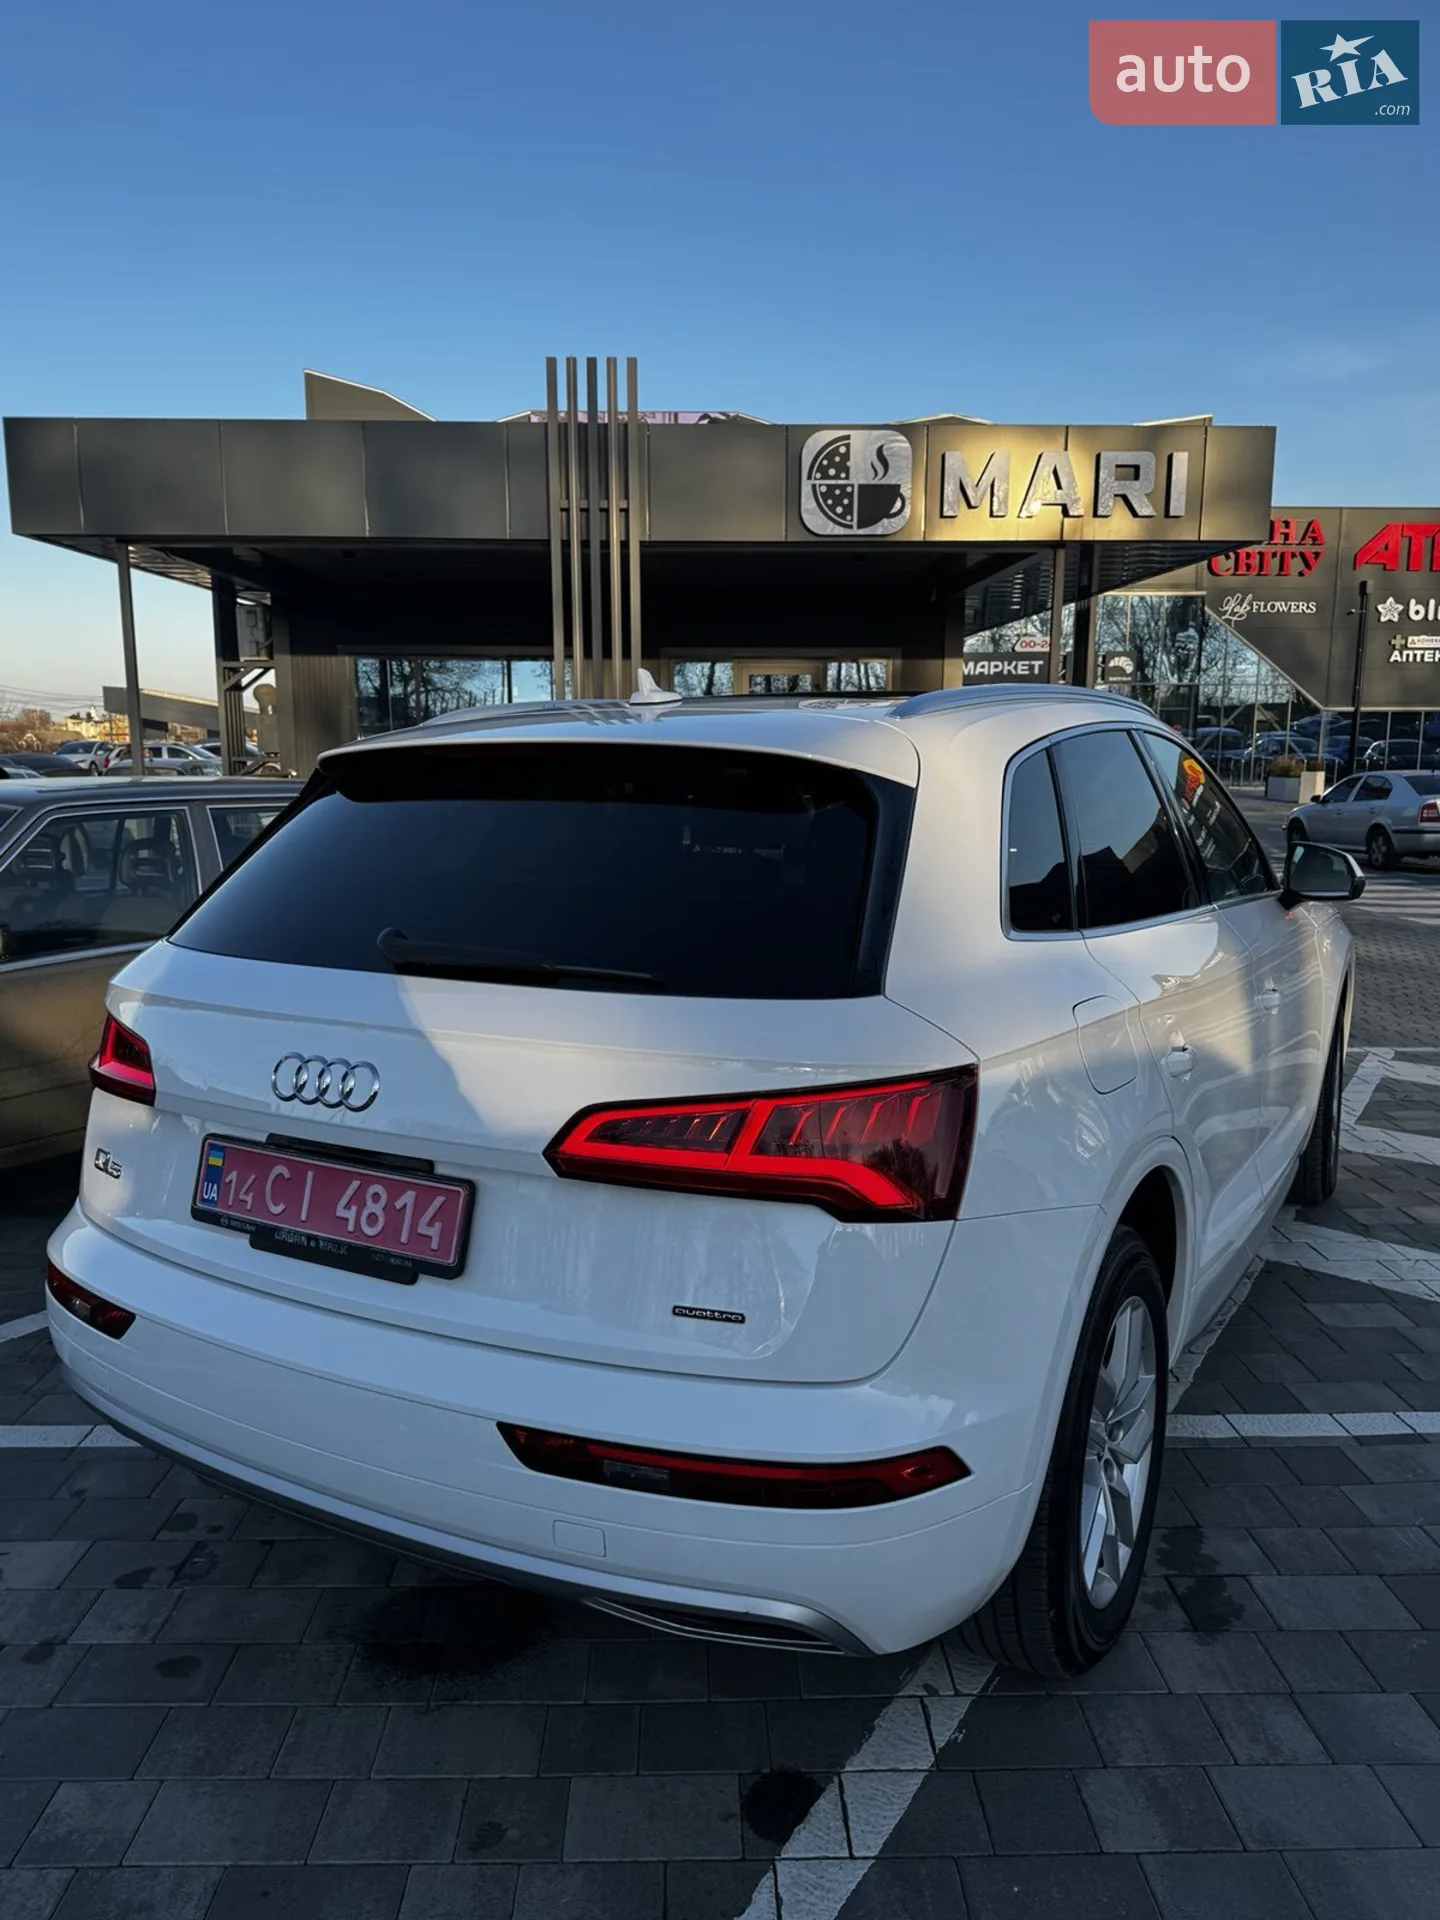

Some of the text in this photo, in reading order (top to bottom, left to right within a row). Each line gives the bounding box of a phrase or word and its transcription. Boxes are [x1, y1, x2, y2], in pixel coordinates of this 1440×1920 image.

[940, 451, 1189, 518] MARI
[1354, 523, 1440, 571] АТ
[1208, 548, 1325, 576] СВІТУ
[1252, 601, 1317, 613] FLOWERS
[1408, 598, 1440, 621] bl
[1019, 640, 1050, 650] 00-2
[203, 1181, 218, 1201] UA
[336, 1180, 447, 1251] 4814
[675, 1308, 742, 1321] quattro
